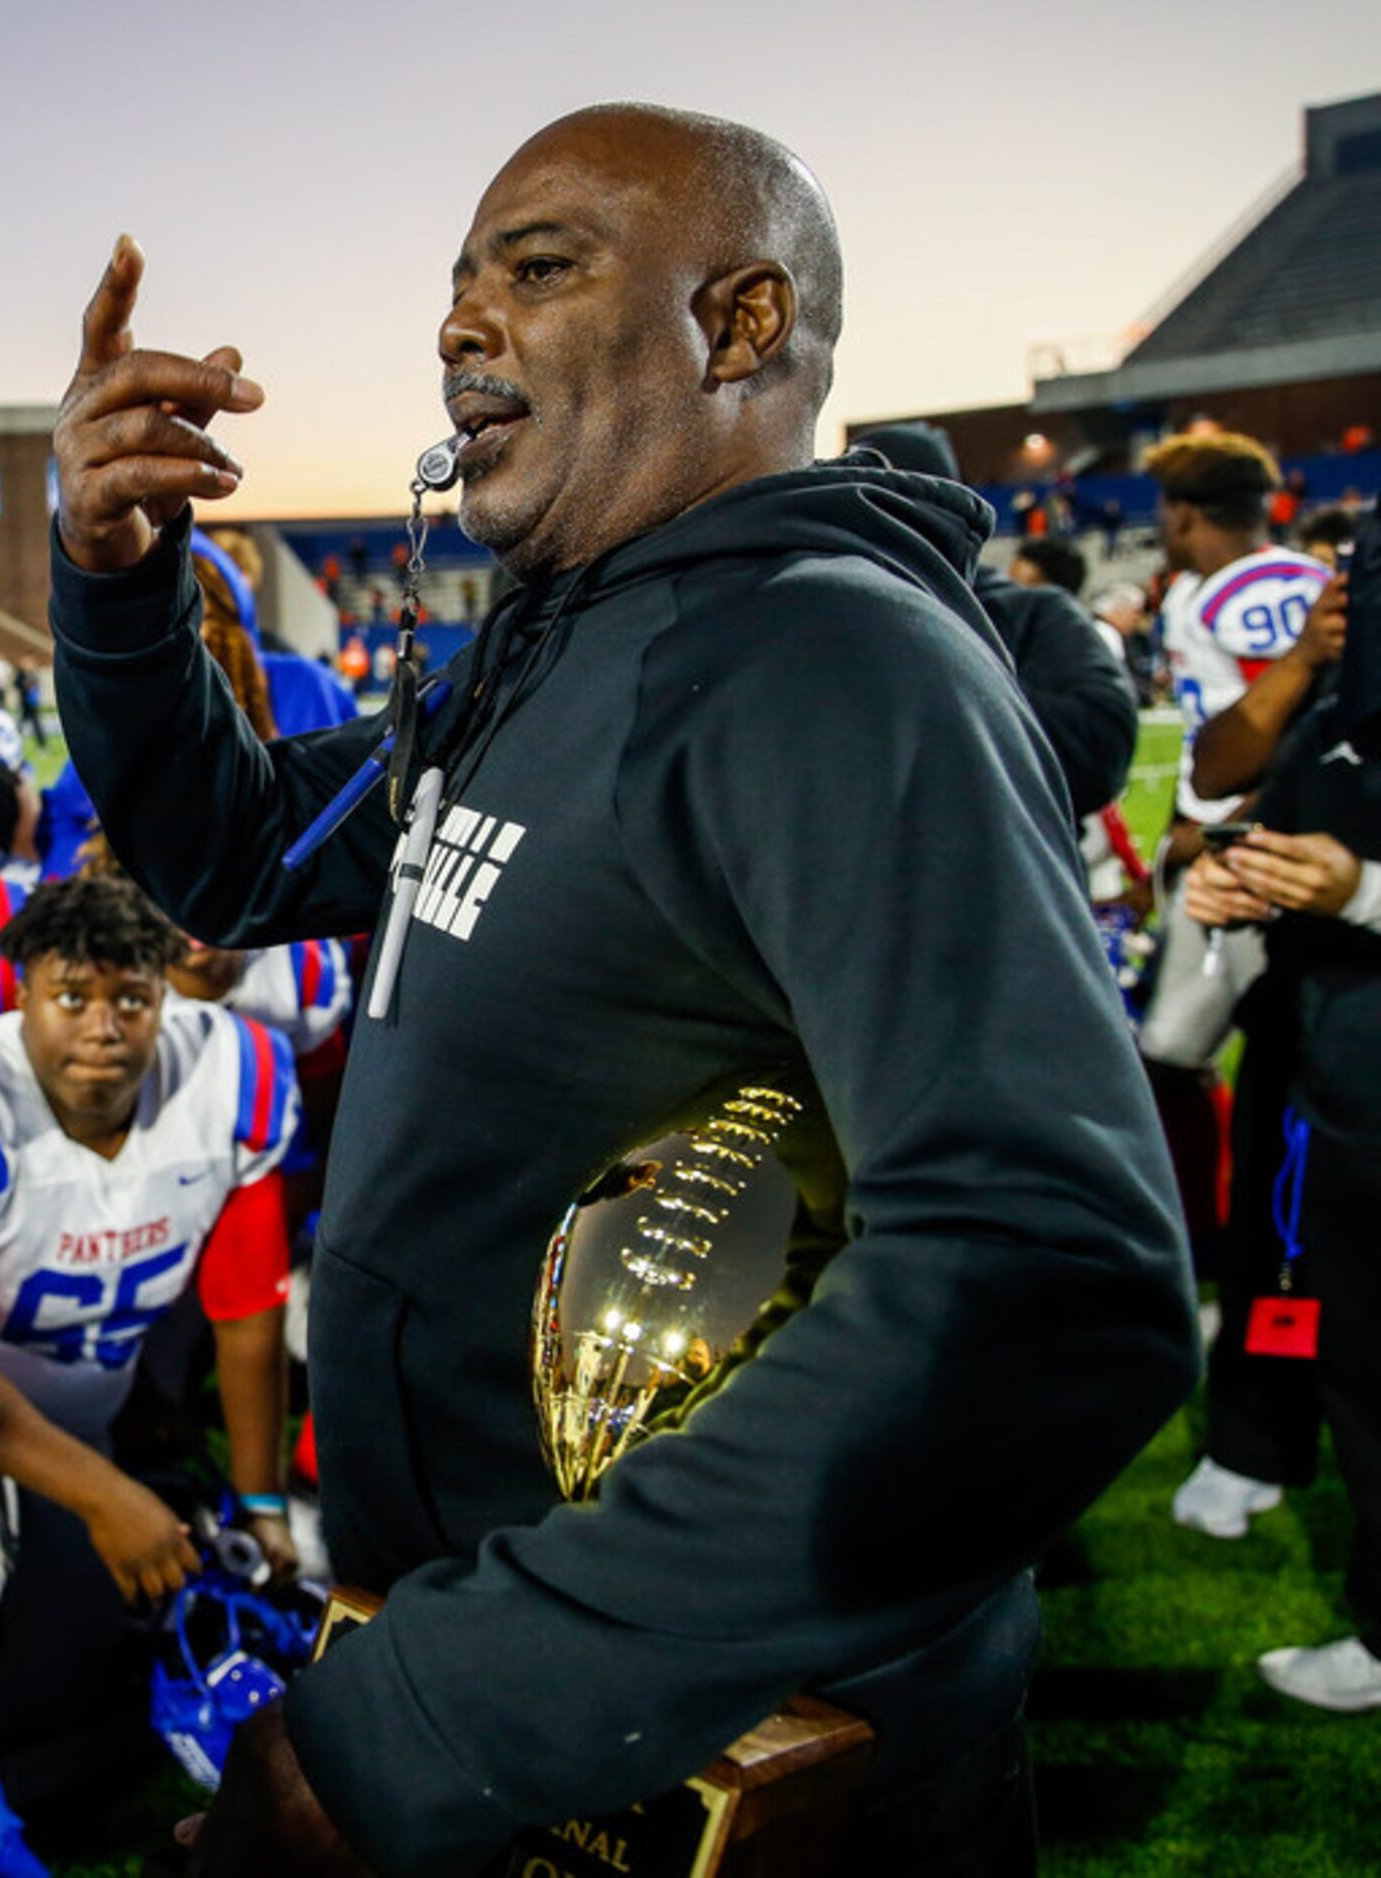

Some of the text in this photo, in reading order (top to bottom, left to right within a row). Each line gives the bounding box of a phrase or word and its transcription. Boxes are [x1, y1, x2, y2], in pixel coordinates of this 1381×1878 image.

[1242, 594, 1312, 650] 90
[56, 1216, 171, 1264] PANTHERS
[0, 1240, 190, 1371] 65
